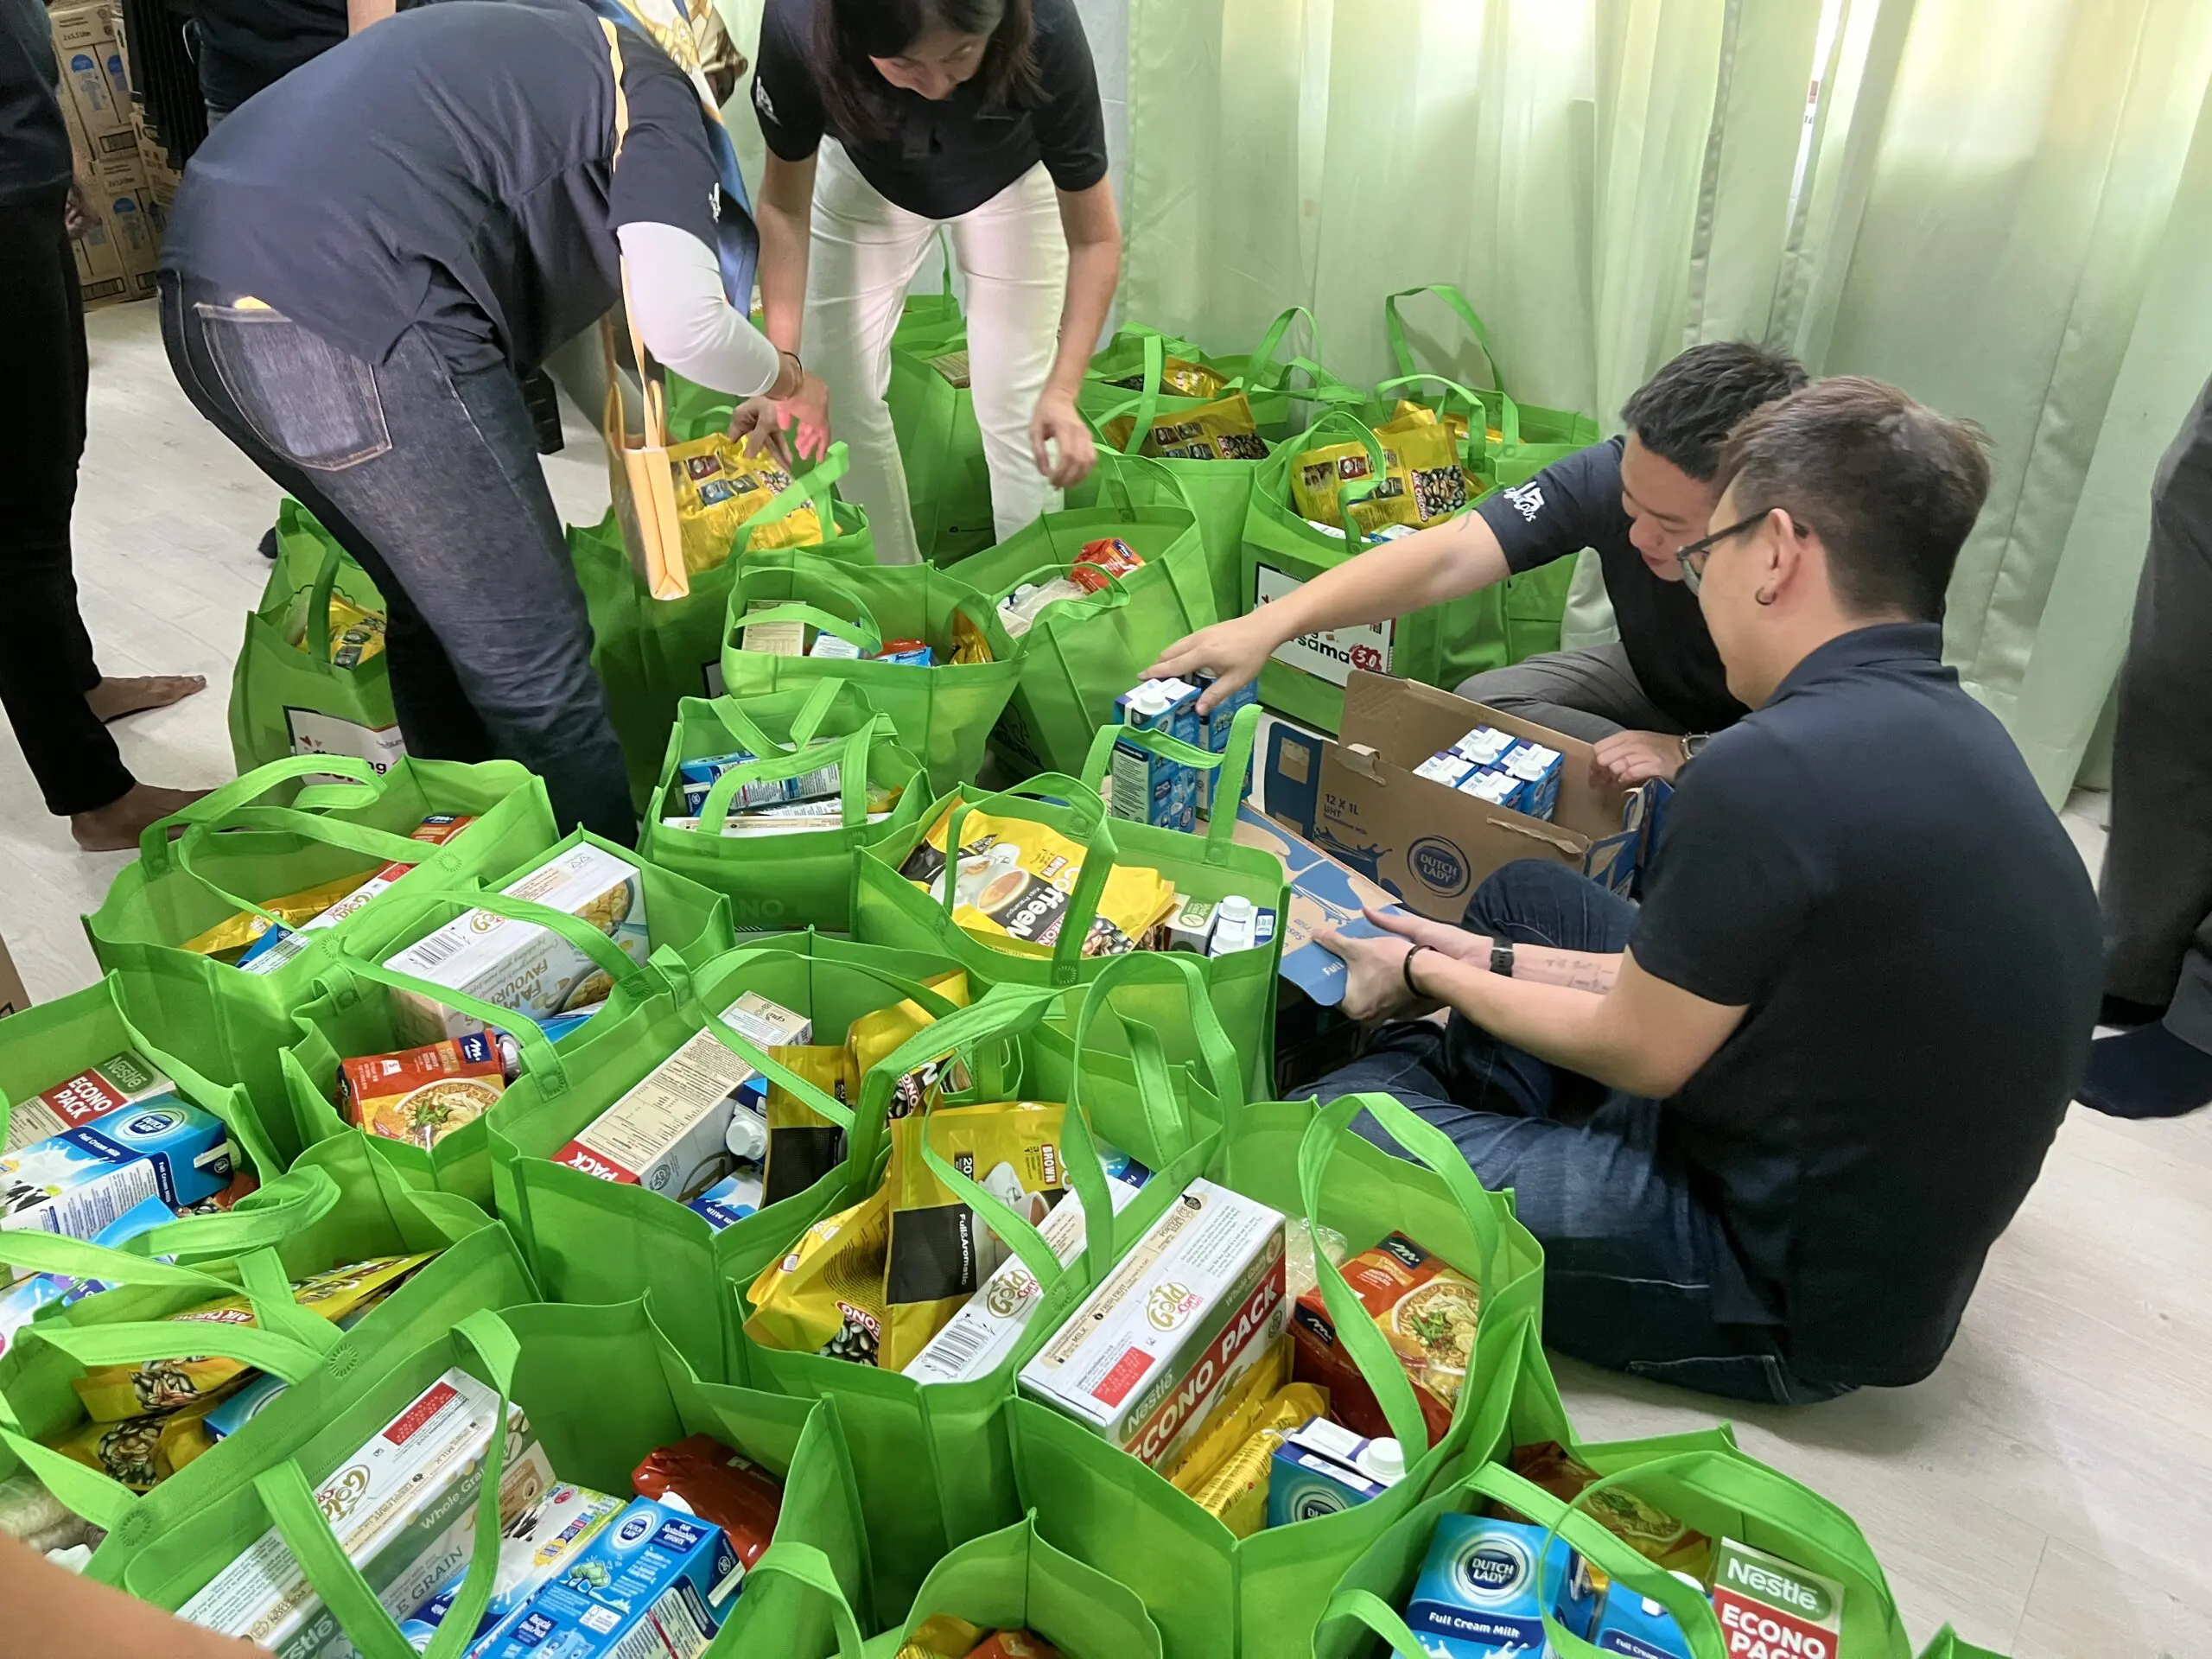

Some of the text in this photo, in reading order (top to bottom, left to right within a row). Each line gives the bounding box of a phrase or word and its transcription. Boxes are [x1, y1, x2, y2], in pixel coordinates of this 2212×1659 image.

[1355, 649, 1377, 668] 3.0
[1325, 794, 1337, 807] 12
[1420, 853, 1459, 877] DUTCH
[1422, 866, 1452, 883] LADY
[1321, 961, 1345, 977] Full
[53, 1089, 92, 1119] PACK
[68, 1076, 114, 1112] ECONO
[1041, 1146, 1056, 1184] BROWN
[990, 1269, 1028, 1314] Gold
[1150, 1283, 1186, 1327] Gold
[1221, 1274, 1279, 1364] PACK
[419, 1493, 460, 1529] Whole
[410, 1545, 464, 1604] GRAIN
[1471, 1558, 1514, 1574] DUTCH
[1473, 1570, 1505, 1584] LADY
[1428, 1611, 1521, 1638] Full Cream Milk
[1721, 1602, 1826, 1659] ECONO
